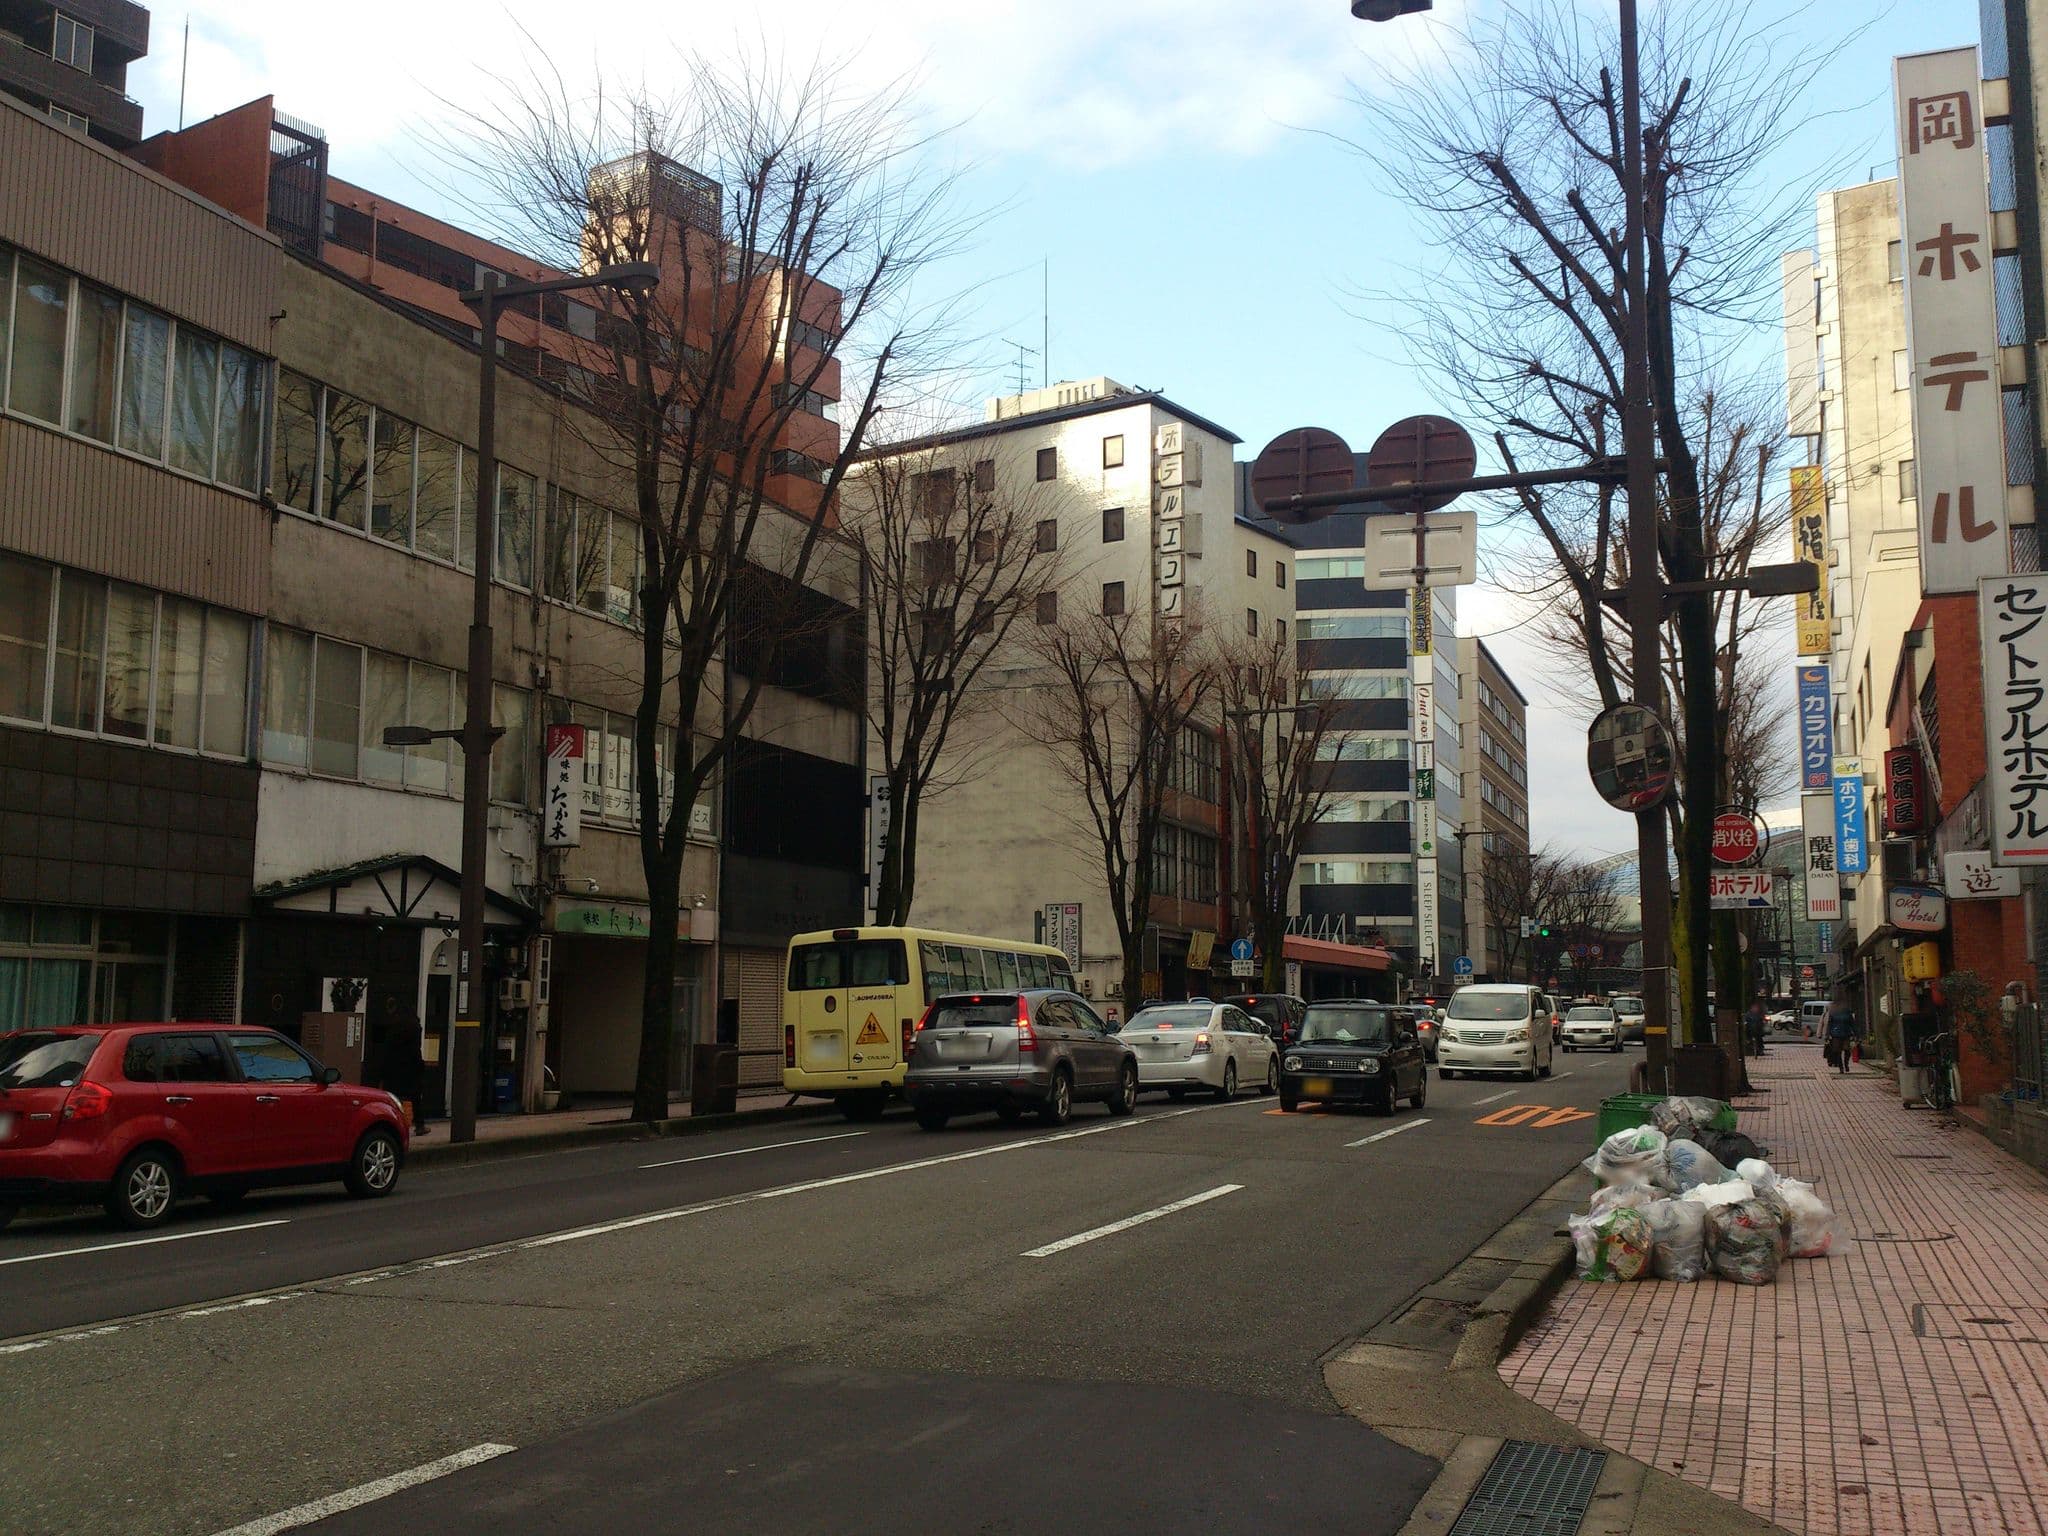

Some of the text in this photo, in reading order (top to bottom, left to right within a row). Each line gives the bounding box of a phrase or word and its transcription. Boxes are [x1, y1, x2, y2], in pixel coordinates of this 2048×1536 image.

[1908, 90, 1997, 545] 岡ホテル
[1805, 633, 1823, 647] 2F
[1804, 695, 1828, 769] カラオケ
[1994, 583, 2048, 840] セントラルホテル
[1712, 828, 1754, 848] 消火栓
[1839, 781, 1861, 868] ホワイト歯科
[1423, 882, 1432, 911] SLEEP
[1907, 909, 1939, 923] Hotel
